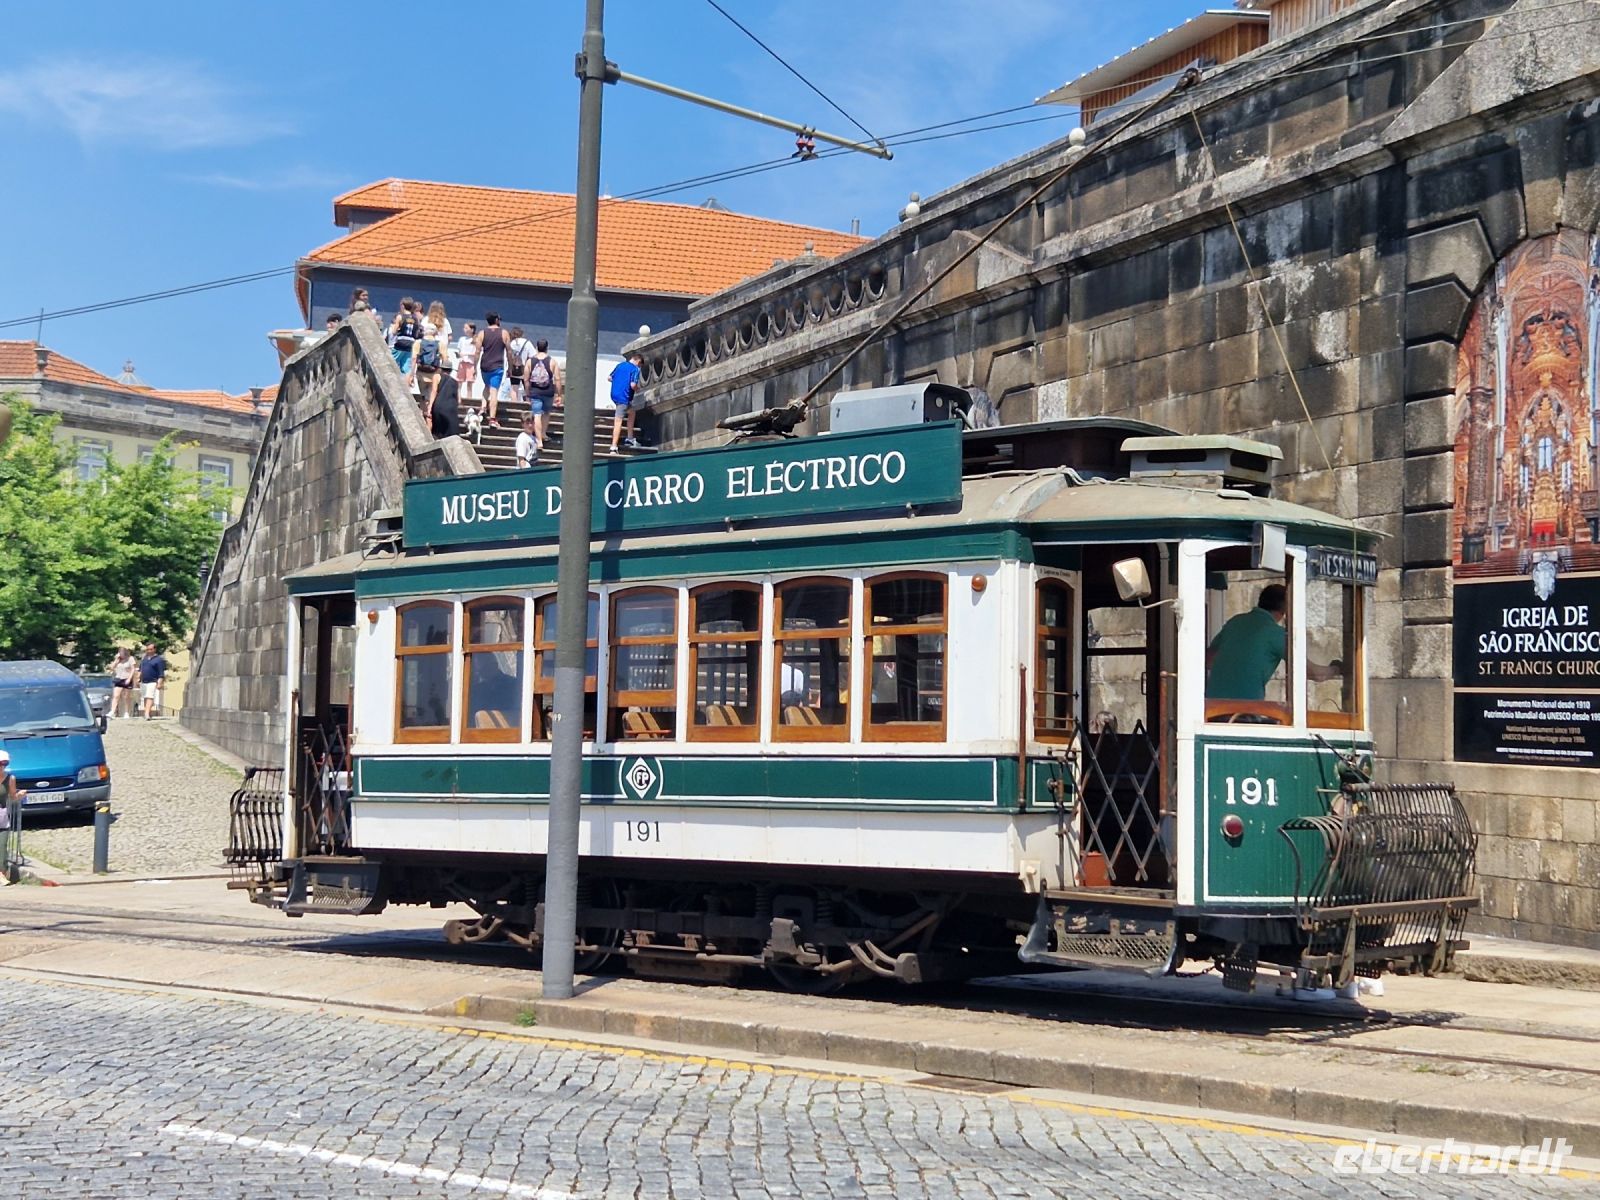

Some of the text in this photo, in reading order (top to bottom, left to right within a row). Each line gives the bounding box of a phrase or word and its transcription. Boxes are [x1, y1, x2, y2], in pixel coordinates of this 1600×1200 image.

[442, 451, 906, 525] MUSEU D CARRO ELÉCTRICO
[1320, 554, 1377, 580] RESERVADO
[1502, 605, 1589, 629] IGREJA DE
[1479, 630, 1600, 653] SÃO FRANCISC
[1479, 661, 1496, 675] ST.
[1500, 659, 1552, 675] FRANCIS
[1497, 699, 1531, 708] Monumento
[1531, 700, 1557, 709] Nacional
[1557, 701, 1575, 709] desde
[1546, 712, 1571, 720] UNESCO
[1225, 776, 1276, 806] 191
[627, 820, 660, 842] 191
